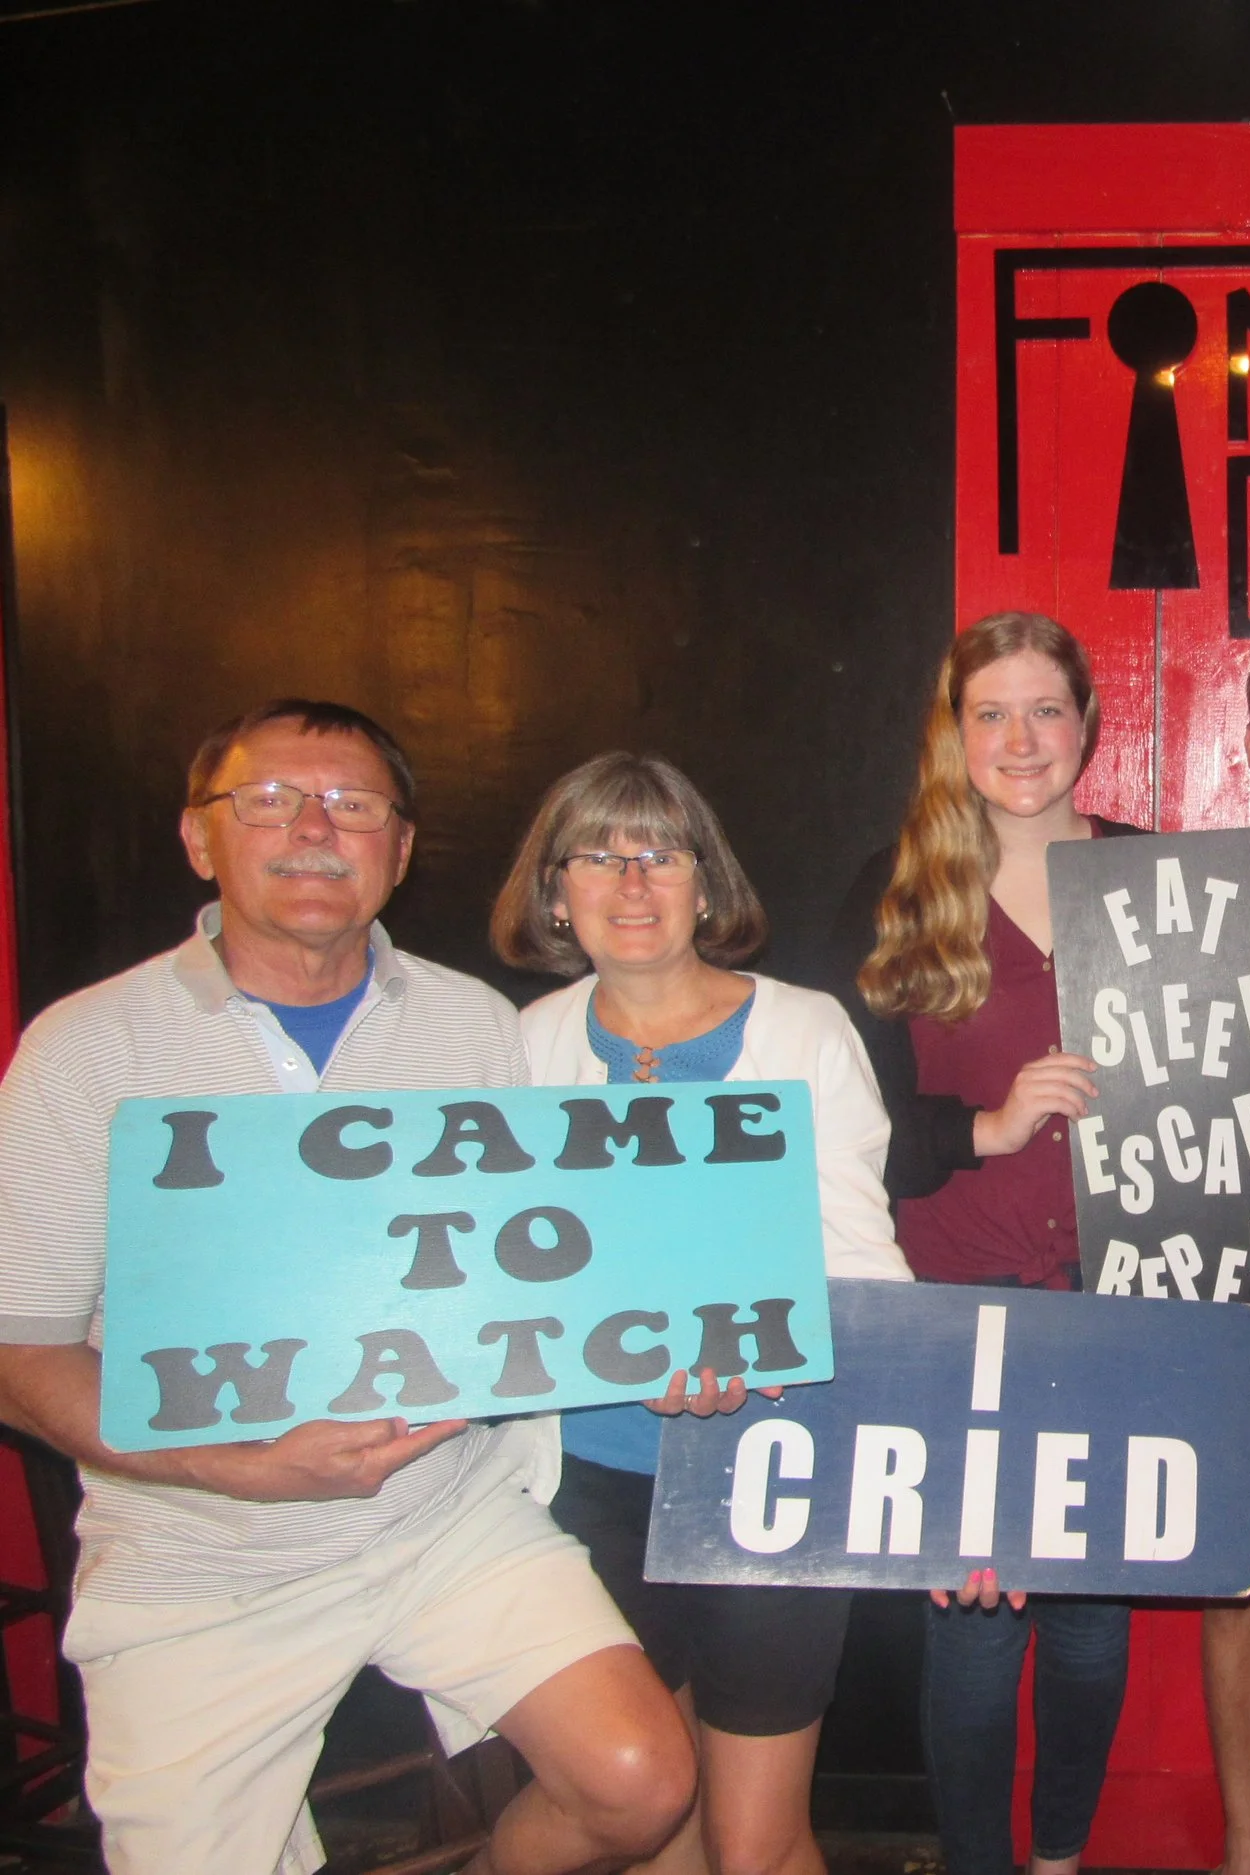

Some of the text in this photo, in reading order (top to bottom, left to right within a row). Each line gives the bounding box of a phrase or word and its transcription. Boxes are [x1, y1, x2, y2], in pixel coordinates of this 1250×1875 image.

[1103, 857, 1239, 967] EAT
[152, 1092, 787, 1190] I CAME
[387, 1206, 593, 1290] TO
[141, 1298, 807, 1432] WATCH
[971, 1305, 1006, 1411] I
[729, 1419, 1199, 1562] CRIED
